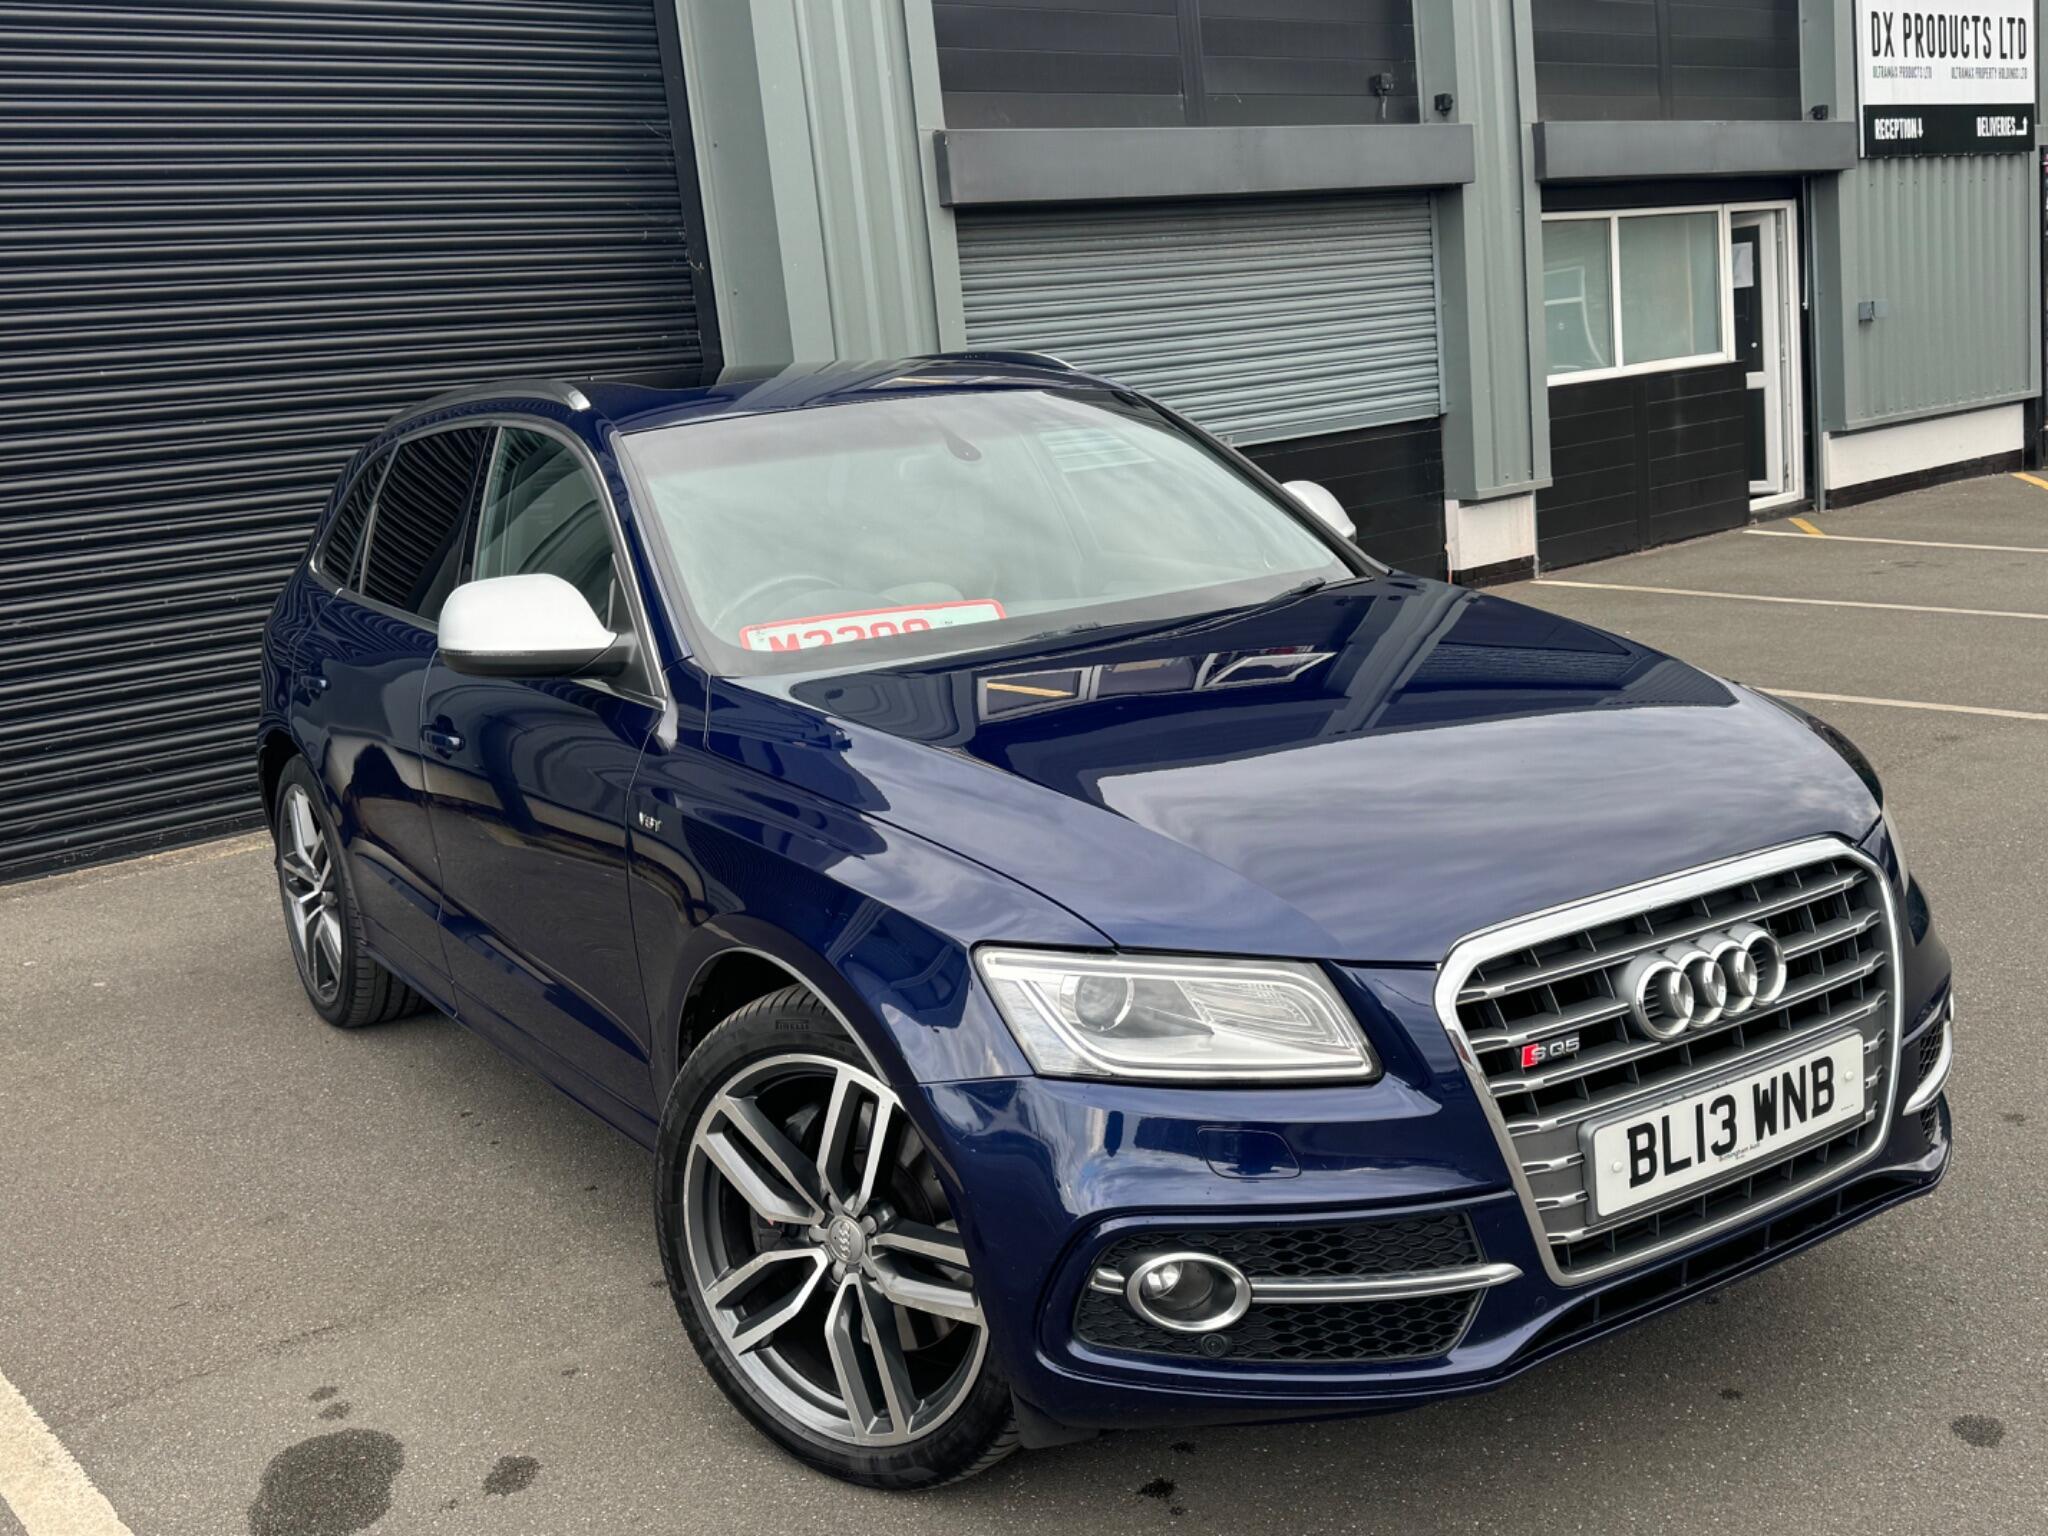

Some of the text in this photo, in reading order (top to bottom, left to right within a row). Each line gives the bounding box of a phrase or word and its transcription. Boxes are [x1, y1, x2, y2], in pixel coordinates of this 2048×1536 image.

[1871, 11, 2027, 60] DX PRODUCTS LTD
[1874, 118, 1917, 140] RECEPTION
[1976, 116, 2016, 137] DELIVERIES
[1626, 1055, 1835, 1189] BL13 WNB
